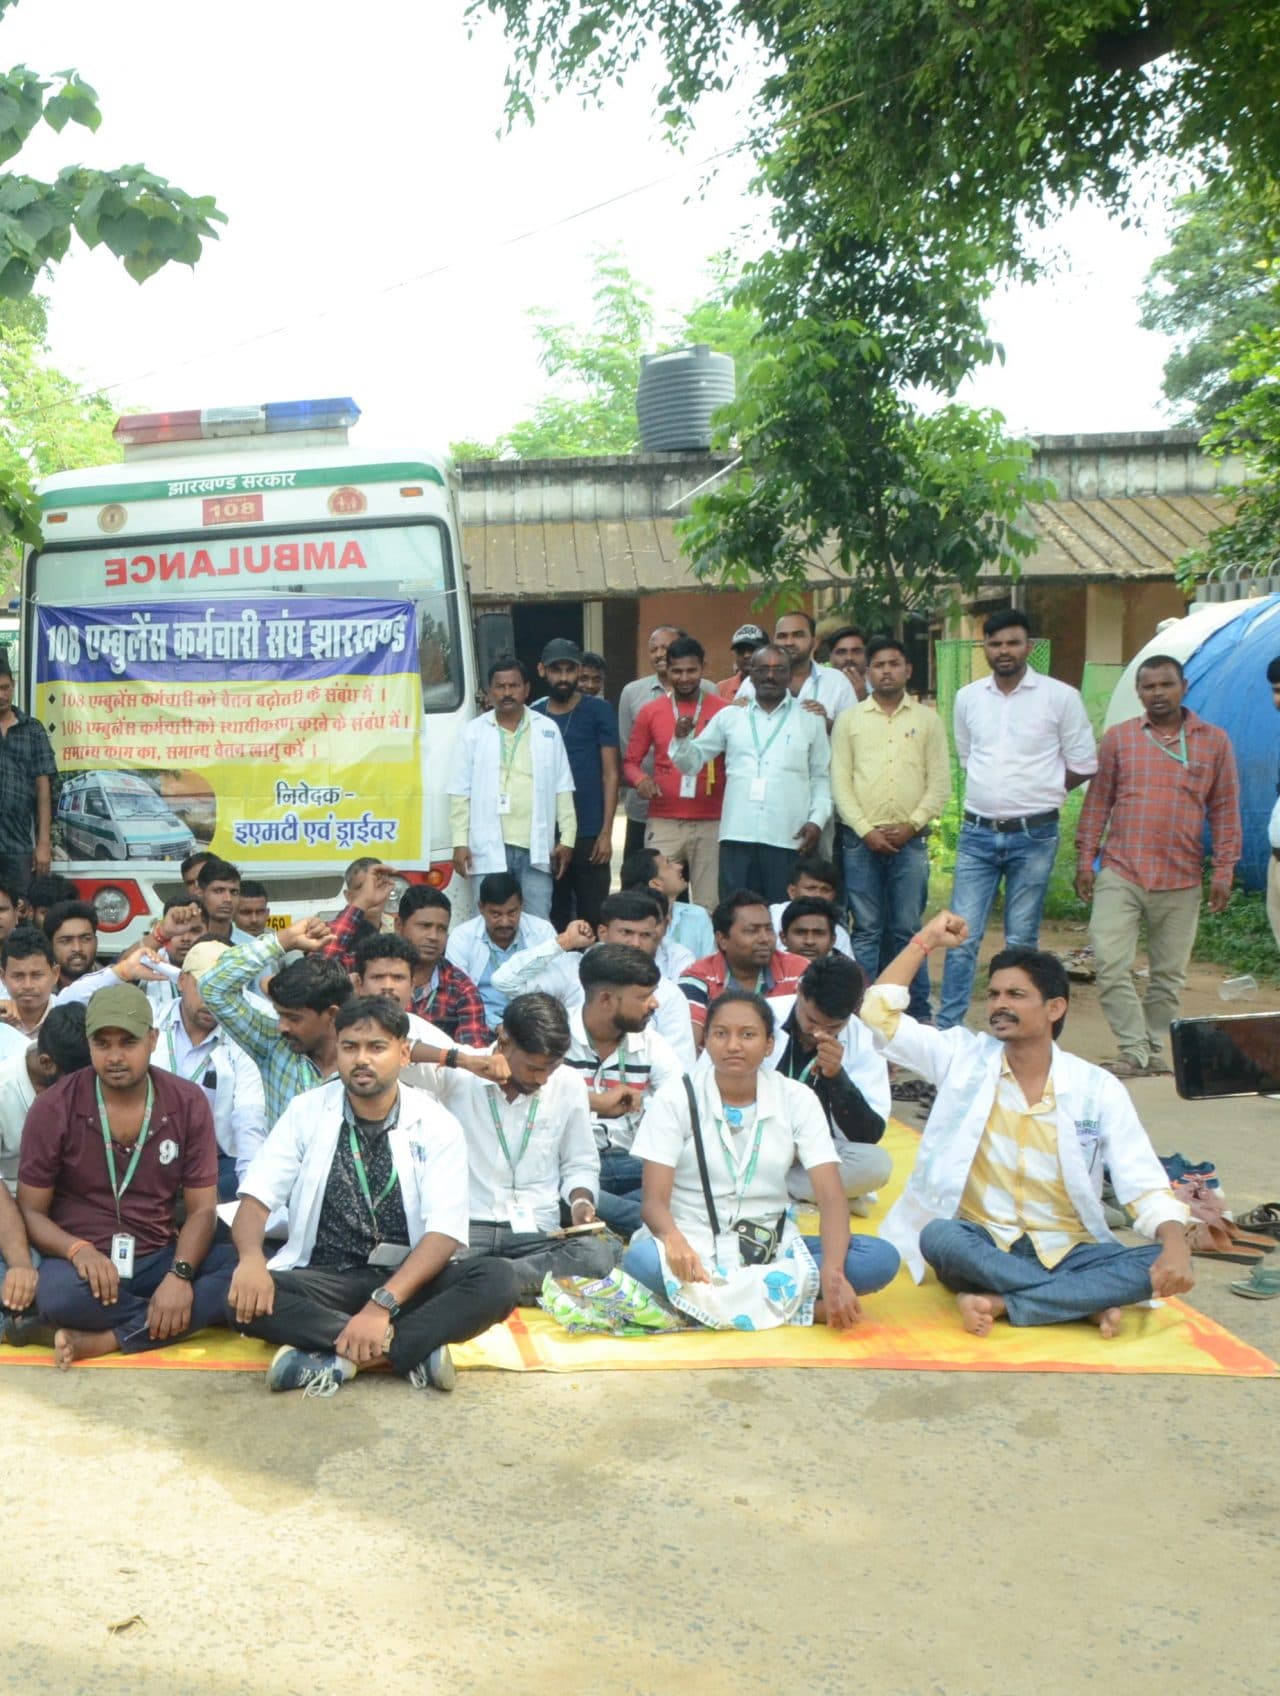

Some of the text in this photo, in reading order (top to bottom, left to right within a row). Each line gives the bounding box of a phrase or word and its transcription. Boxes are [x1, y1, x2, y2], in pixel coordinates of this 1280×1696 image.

[167, 471, 297, 497] झारखण्ड सरकार
[209, 501, 257, 518] 108
[46, 624, 81, 665] 108
[84, 612, 169, 675] एम्बुलेंस
[173, 608, 261, 660] कर्मचारी
[265, 608, 306, 659] संघ
[88, 688, 137, 713] एम्बुलेंस
[141, 690, 193, 708] कर्मचारी
[61, 720, 82, 736] 108
[86, 716, 136, 739] एम्बुलेंस
[140, 716, 193, 736] कर्मचारी
[196, 717, 215, 735] को
[104, 745, 135, 760] काम
[276, 781, 341, 806] निवेदक
[235, 812, 397, 847] इएमटी एवं ड्राईवर
